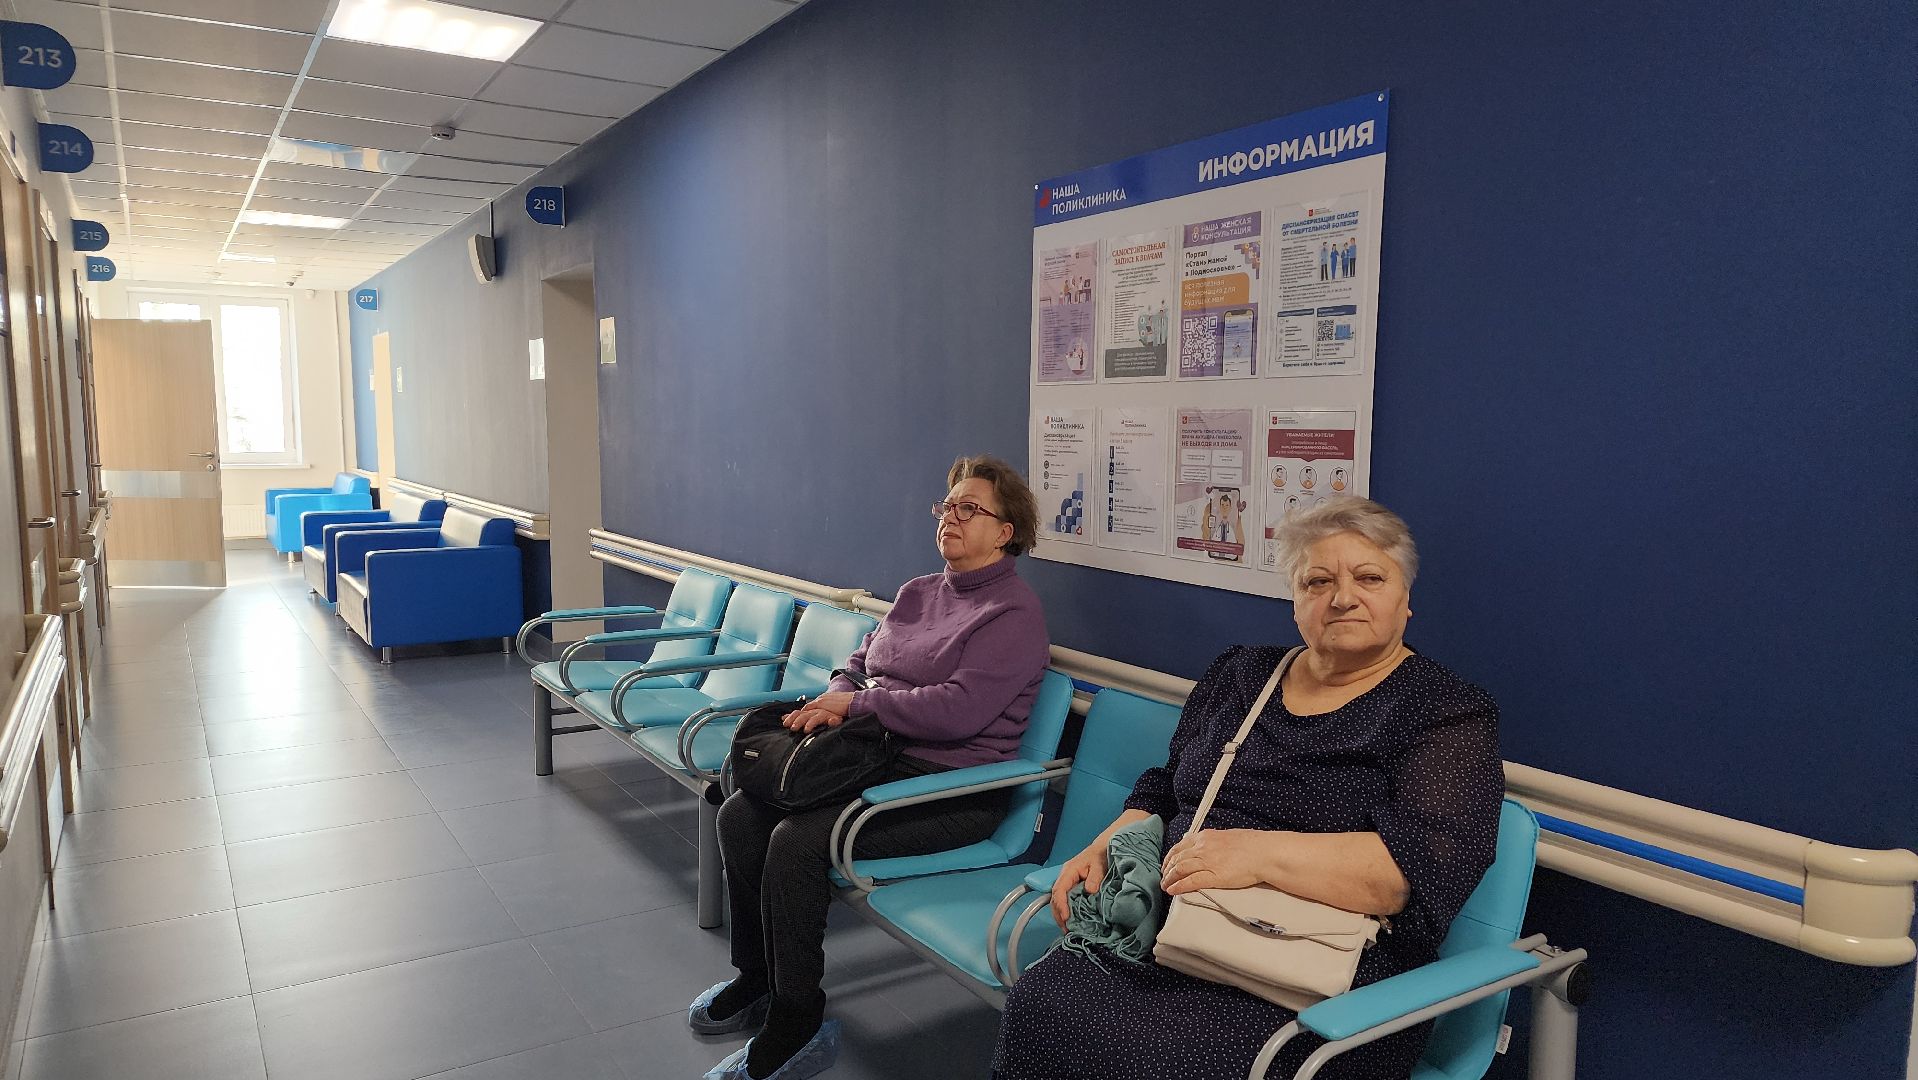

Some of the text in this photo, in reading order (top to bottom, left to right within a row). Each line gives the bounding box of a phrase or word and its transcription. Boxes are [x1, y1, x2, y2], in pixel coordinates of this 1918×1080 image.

[17, 45, 62, 68] 213
[48, 139, 83, 157] 214
[1198, 119, 1375, 183] ИНФОРМАЦИЯ
[1052, 182, 1081, 200] НАША
[533, 198, 556, 211] 218
[1052, 187, 1127, 215] ПОЛИКЛИНИКА
[1201, 217, 1252, 232] НАША ЖЕНСКАЯ
[1281, 215, 1336, 231] ДИСПАНСЕРИЗАЦИЯ
[1290, 223, 1331, 235] СМЕРТЕЛЬНОЙ
[80, 230, 102, 241] 215
[1201, 226, 1252, 240] КОНСУЛЬТАЦИЯ
[1185, 251, 1208, 260] Портал
[91, 264, 110, 273] 216
[359, 295, 374, 303] 217
